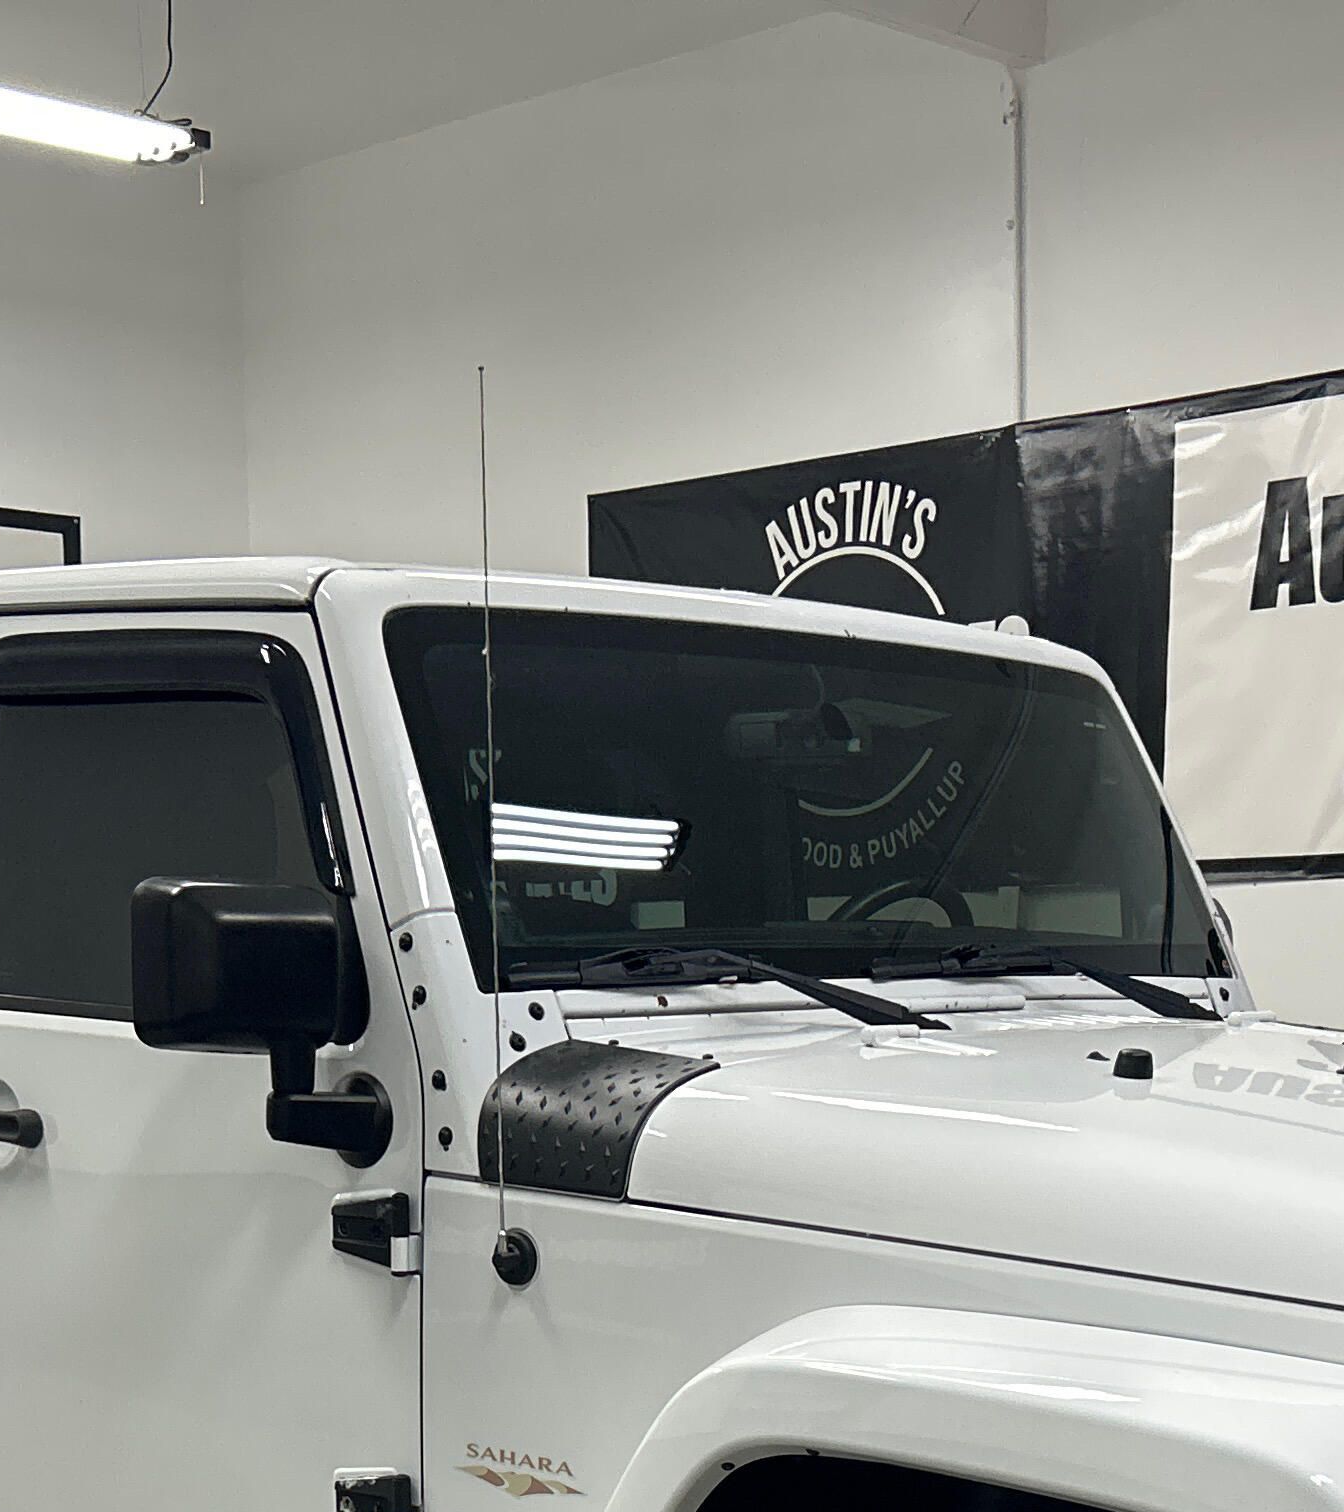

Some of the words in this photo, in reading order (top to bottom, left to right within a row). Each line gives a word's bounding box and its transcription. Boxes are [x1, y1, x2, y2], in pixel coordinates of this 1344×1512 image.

[764, 479, 937, 581] AUSTIN'S
[867, 760, 967, 865] PUYALLUP
[466, 1442, 575, 1477] SAHARA
